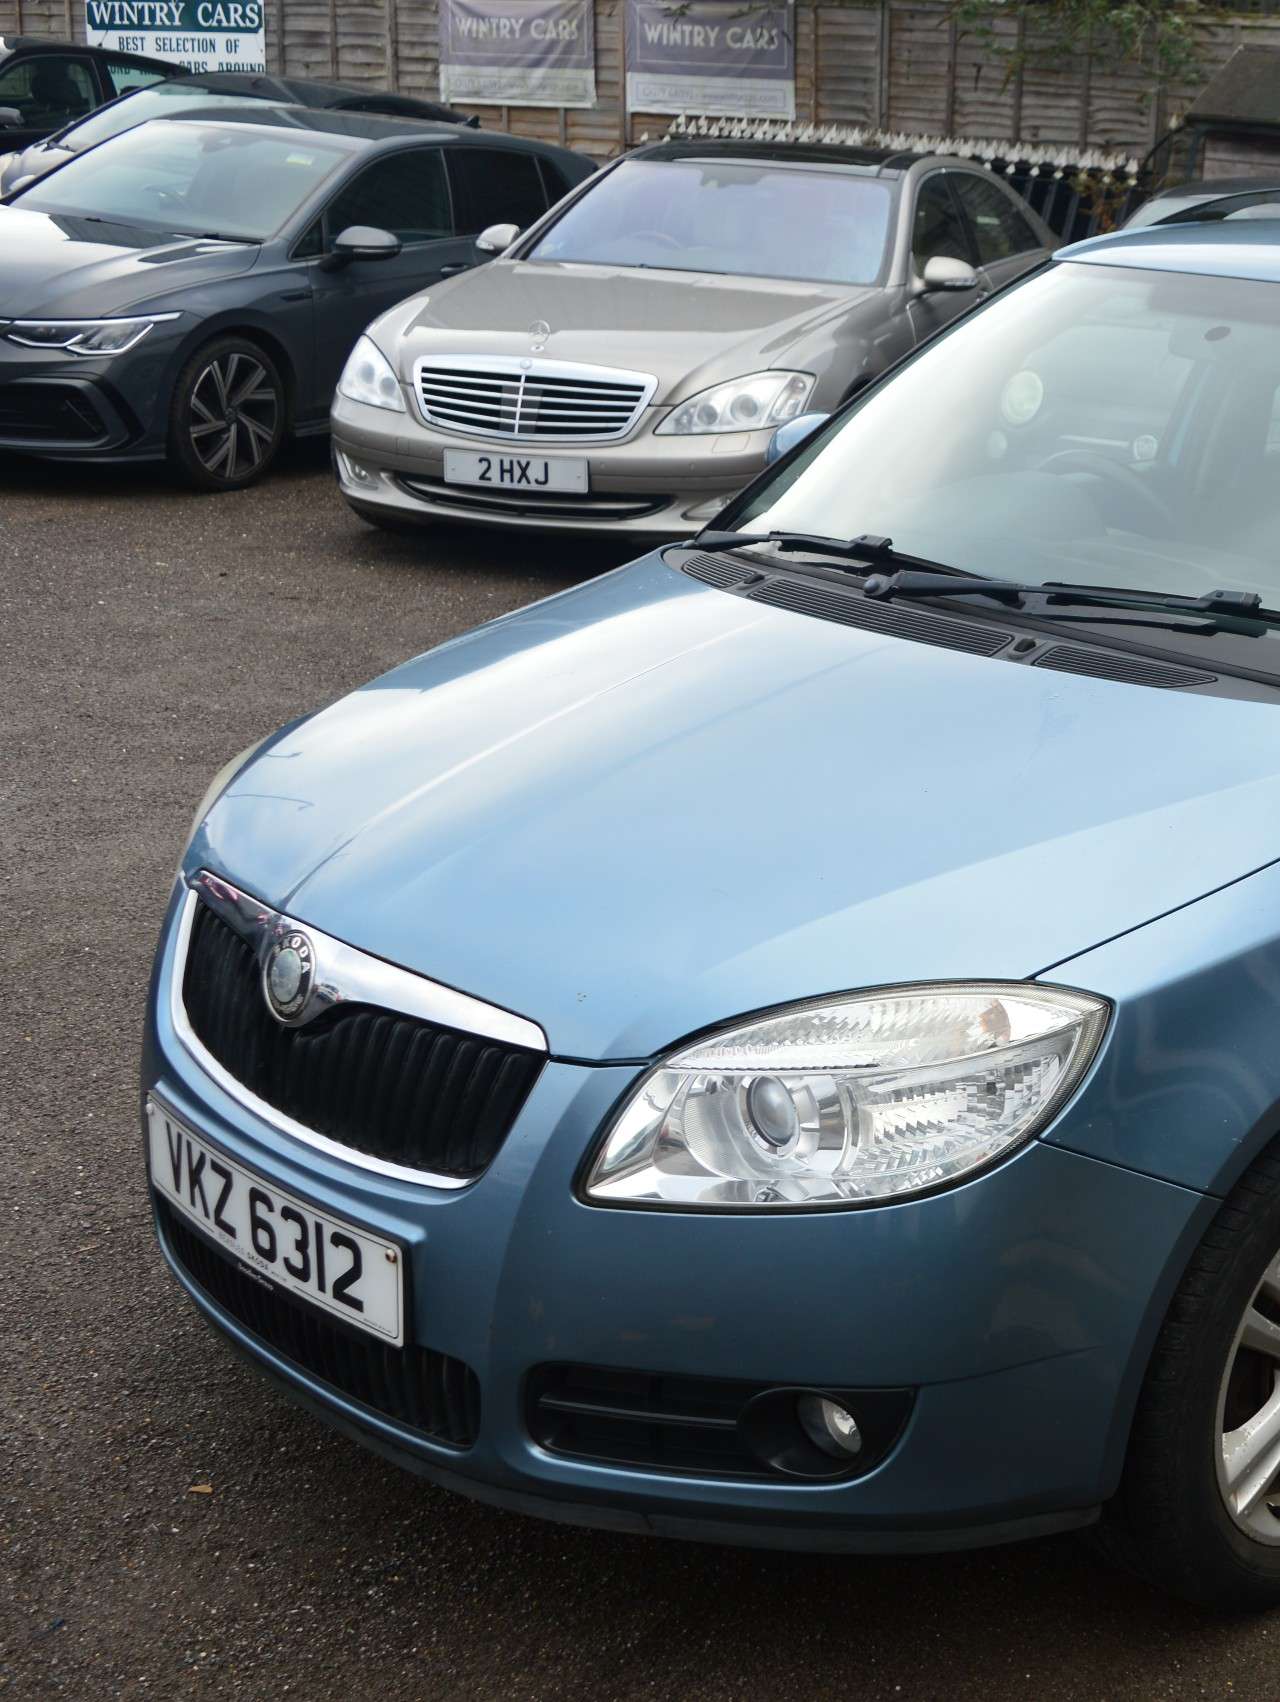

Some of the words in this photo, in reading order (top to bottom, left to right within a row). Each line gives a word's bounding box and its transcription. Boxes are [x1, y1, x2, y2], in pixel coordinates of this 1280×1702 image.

[92, 1, 184, 26] WINTRY
[197, 3, 260, 28] CARS
[454, 16, 524, 40] WINTRY
[530, 18, 579, 40] CARS
[118, 36, 146, 52] BEST
[155, 37, 216, 53] SELECTION
[225, 39, 240, 54] OF
[643, 23, 719, 48] WINTRY
[727, 27, 778, 50] CARS
[478, 456, 492, 481] 2
[500, 458, 549, 486] HXJ
[165, 1120, 237, 1239] VKZ
[249, 1186, 364, 1313] 6312
